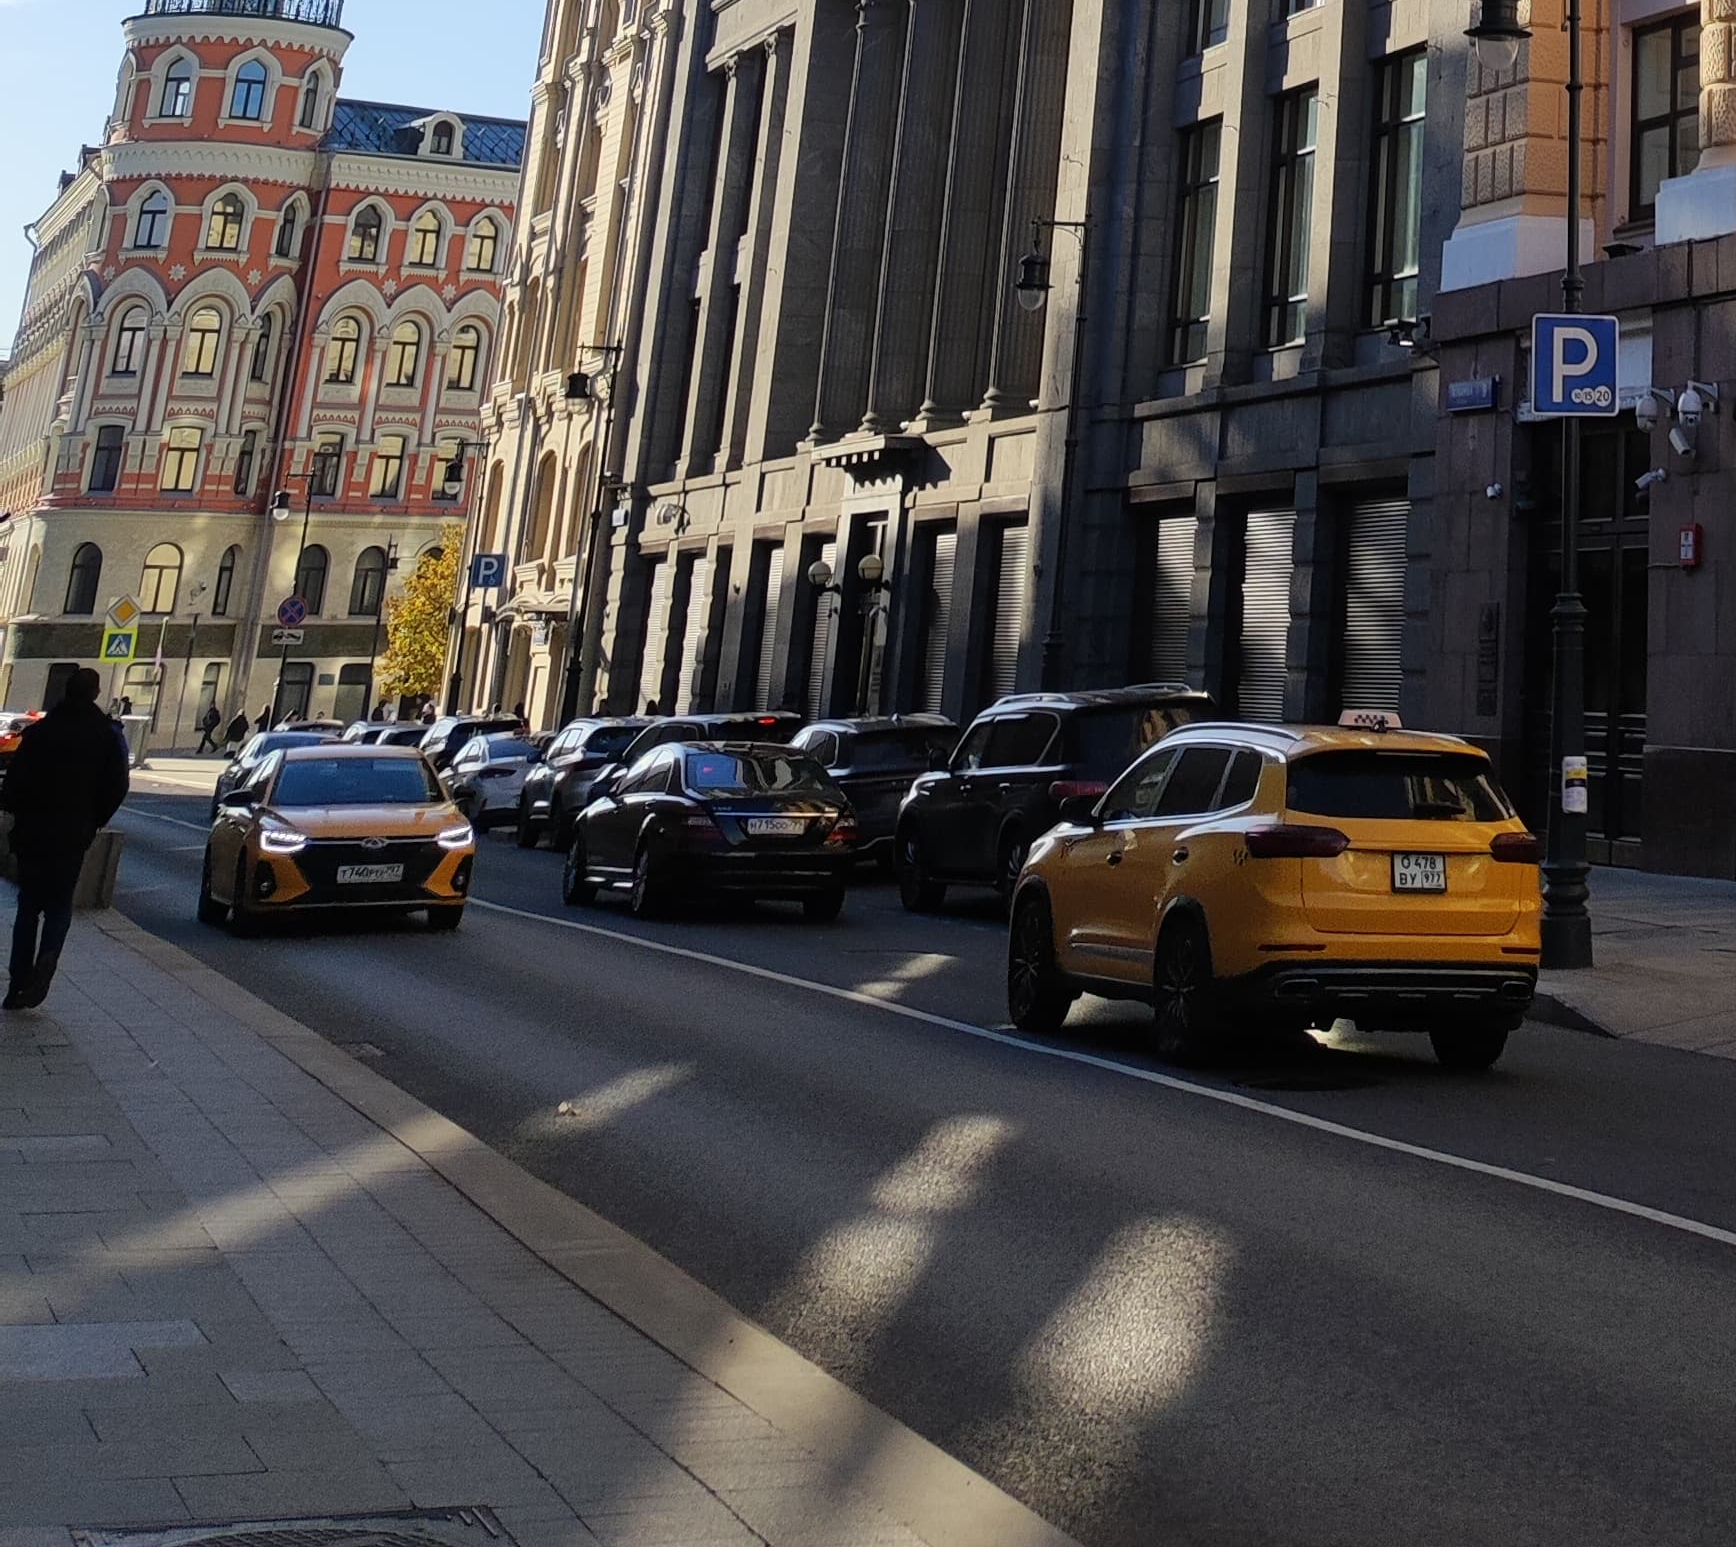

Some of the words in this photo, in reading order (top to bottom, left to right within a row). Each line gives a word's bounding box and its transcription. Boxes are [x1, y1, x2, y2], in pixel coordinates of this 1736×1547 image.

[1552, 326, 1598, 403] P
[1584, 390, 1594, 401] 15
[1596, 389, 1610, 403] 20
[478, 557, 499, 585] P
[1424, 873, 1441, 884] 977
